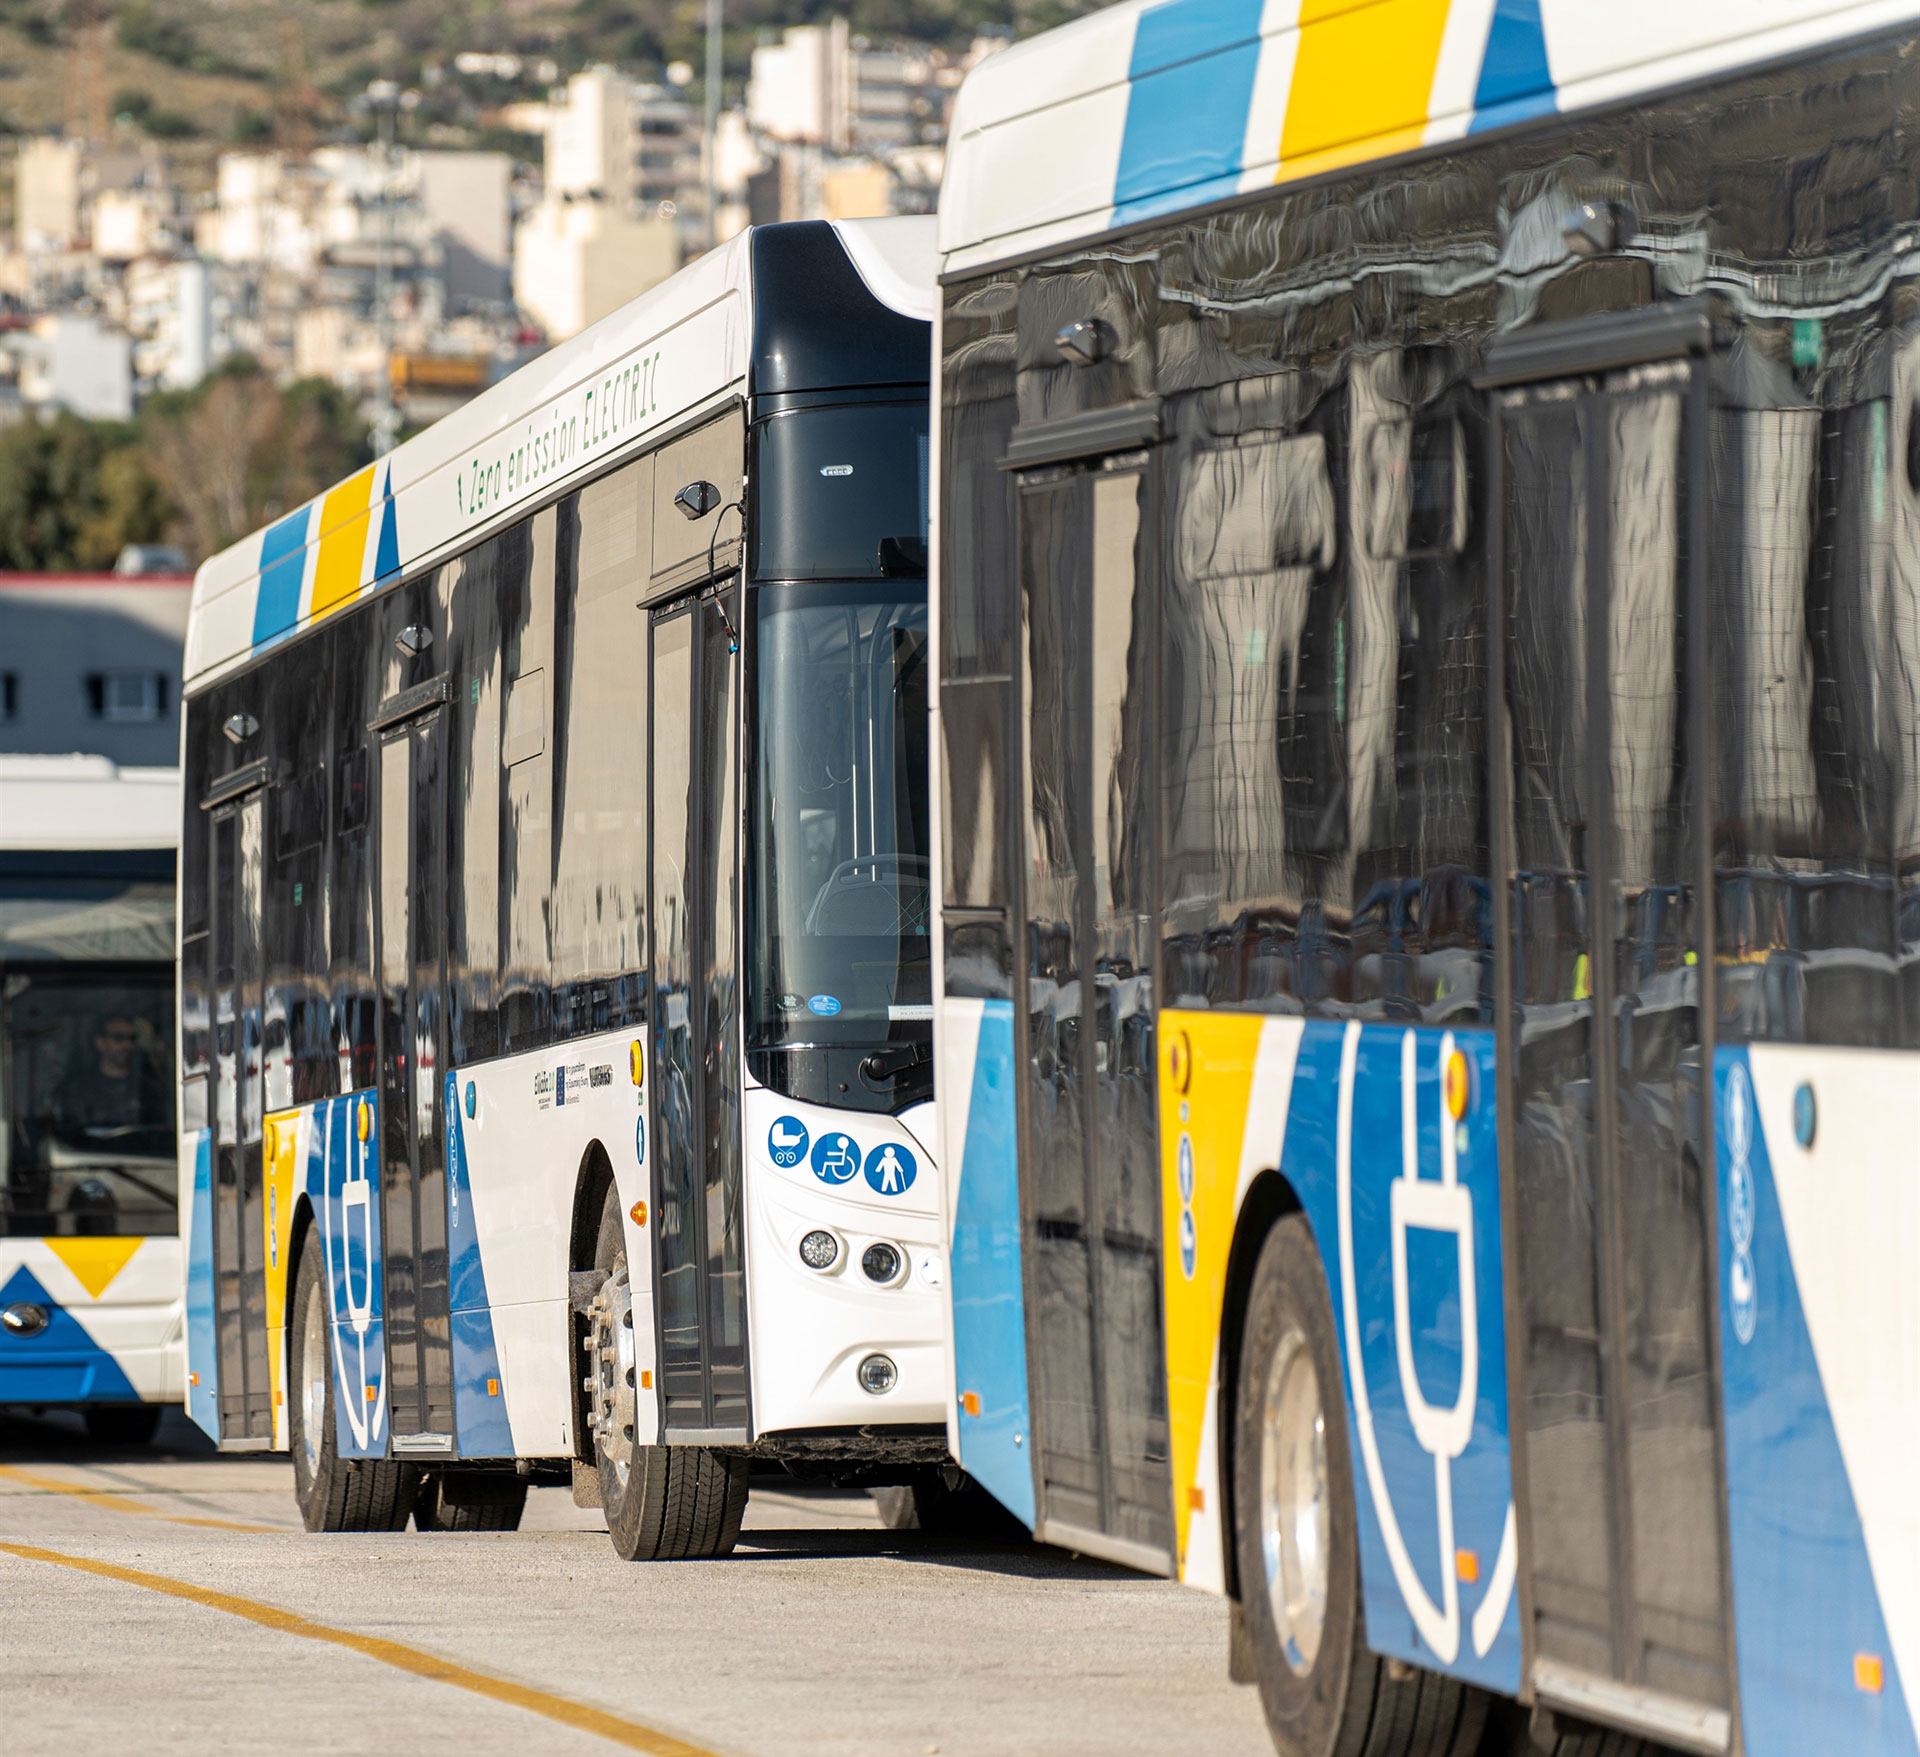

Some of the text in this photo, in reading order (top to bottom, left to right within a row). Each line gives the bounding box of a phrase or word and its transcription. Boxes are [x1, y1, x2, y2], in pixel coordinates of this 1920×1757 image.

[469, 352, 660, 515] Zero emission ELECTRIC
